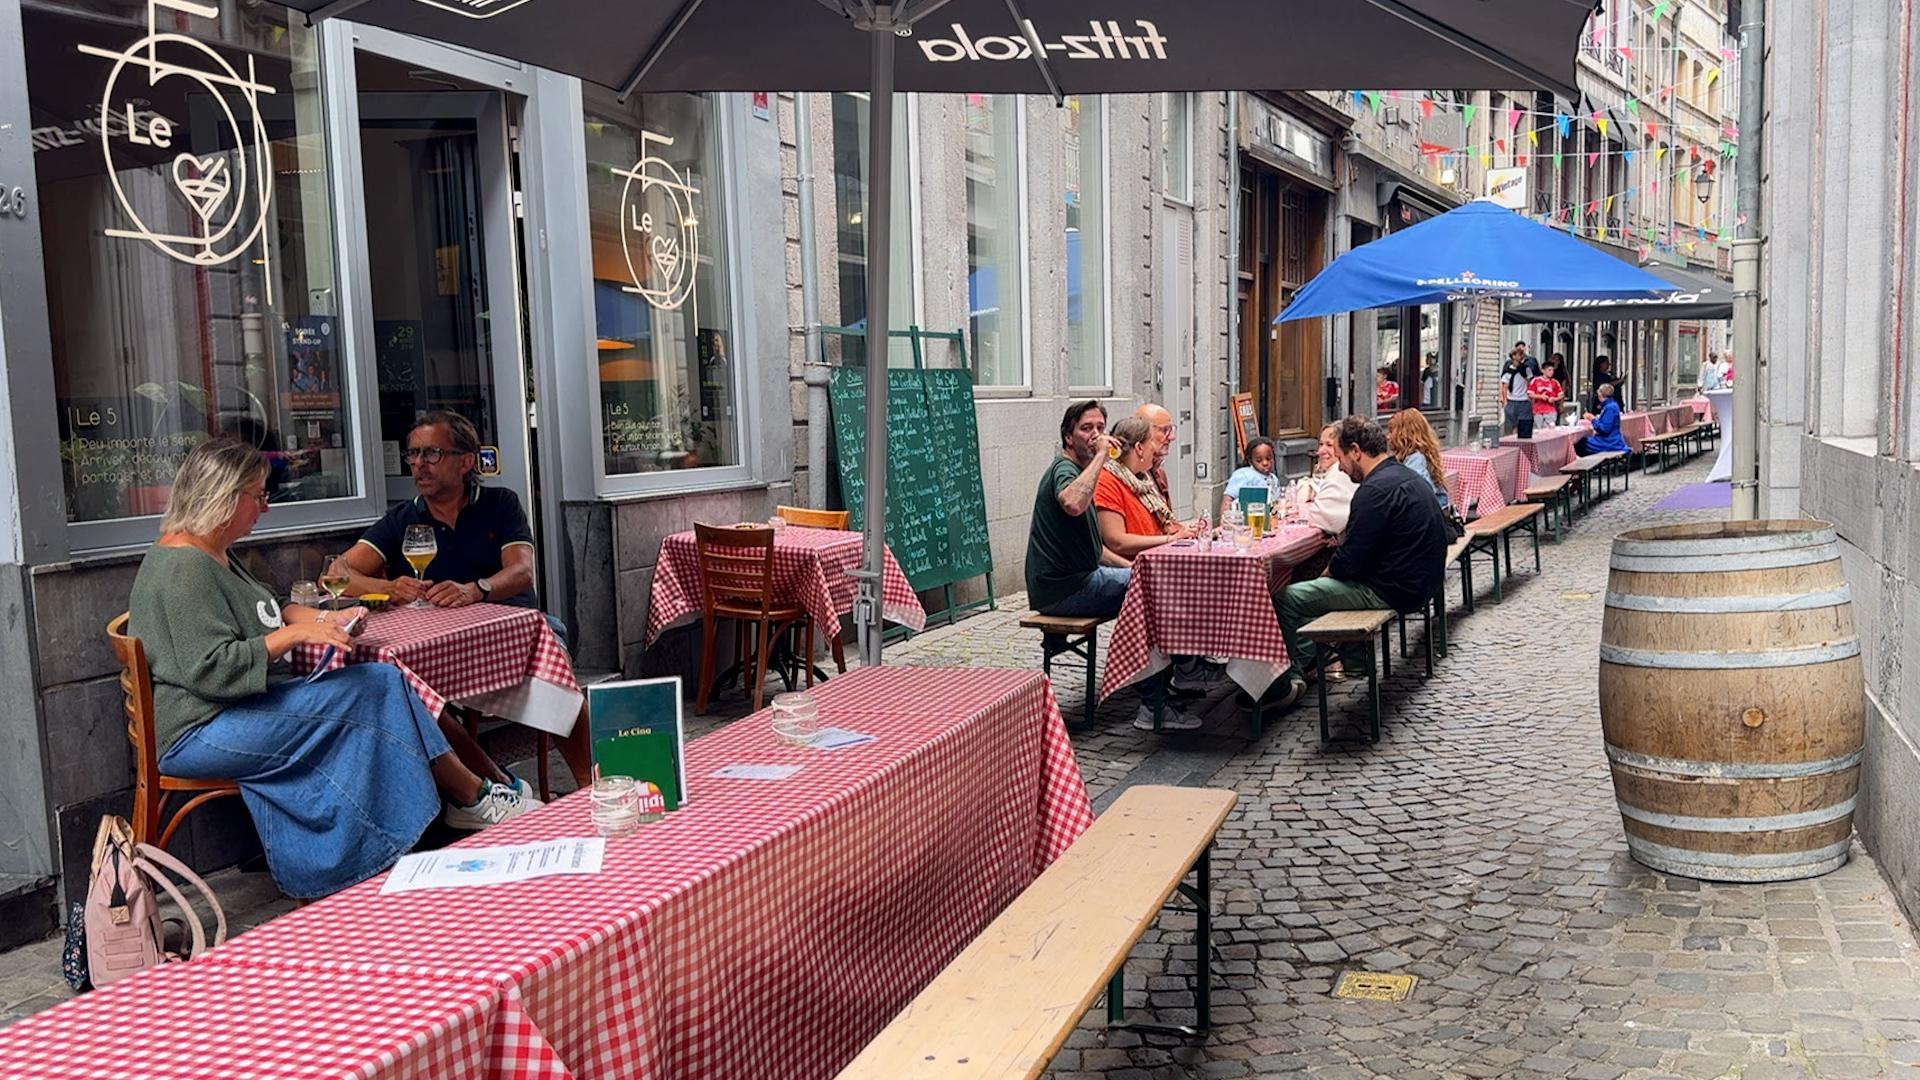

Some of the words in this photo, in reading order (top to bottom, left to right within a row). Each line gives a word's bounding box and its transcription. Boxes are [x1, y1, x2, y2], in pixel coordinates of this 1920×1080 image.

[126, 103, 173, 148] Le
[632, 204, 653, 232] Le
[76, 408, 100, 426] Le
[106, 407, 118, 425] 5
[609, 403, 621, 415] Le
[623, 402, 629, 415] 5
[79, 437, 104, 450] Peu
[106, 436, 155, 451] importe
[158, 435, 169, 447] le
[171, 435, 197, 447] sens
[140, 469, 152, 480] et
[155, 468, 178, 480] pro
[618, 729, 629, 737] Le
